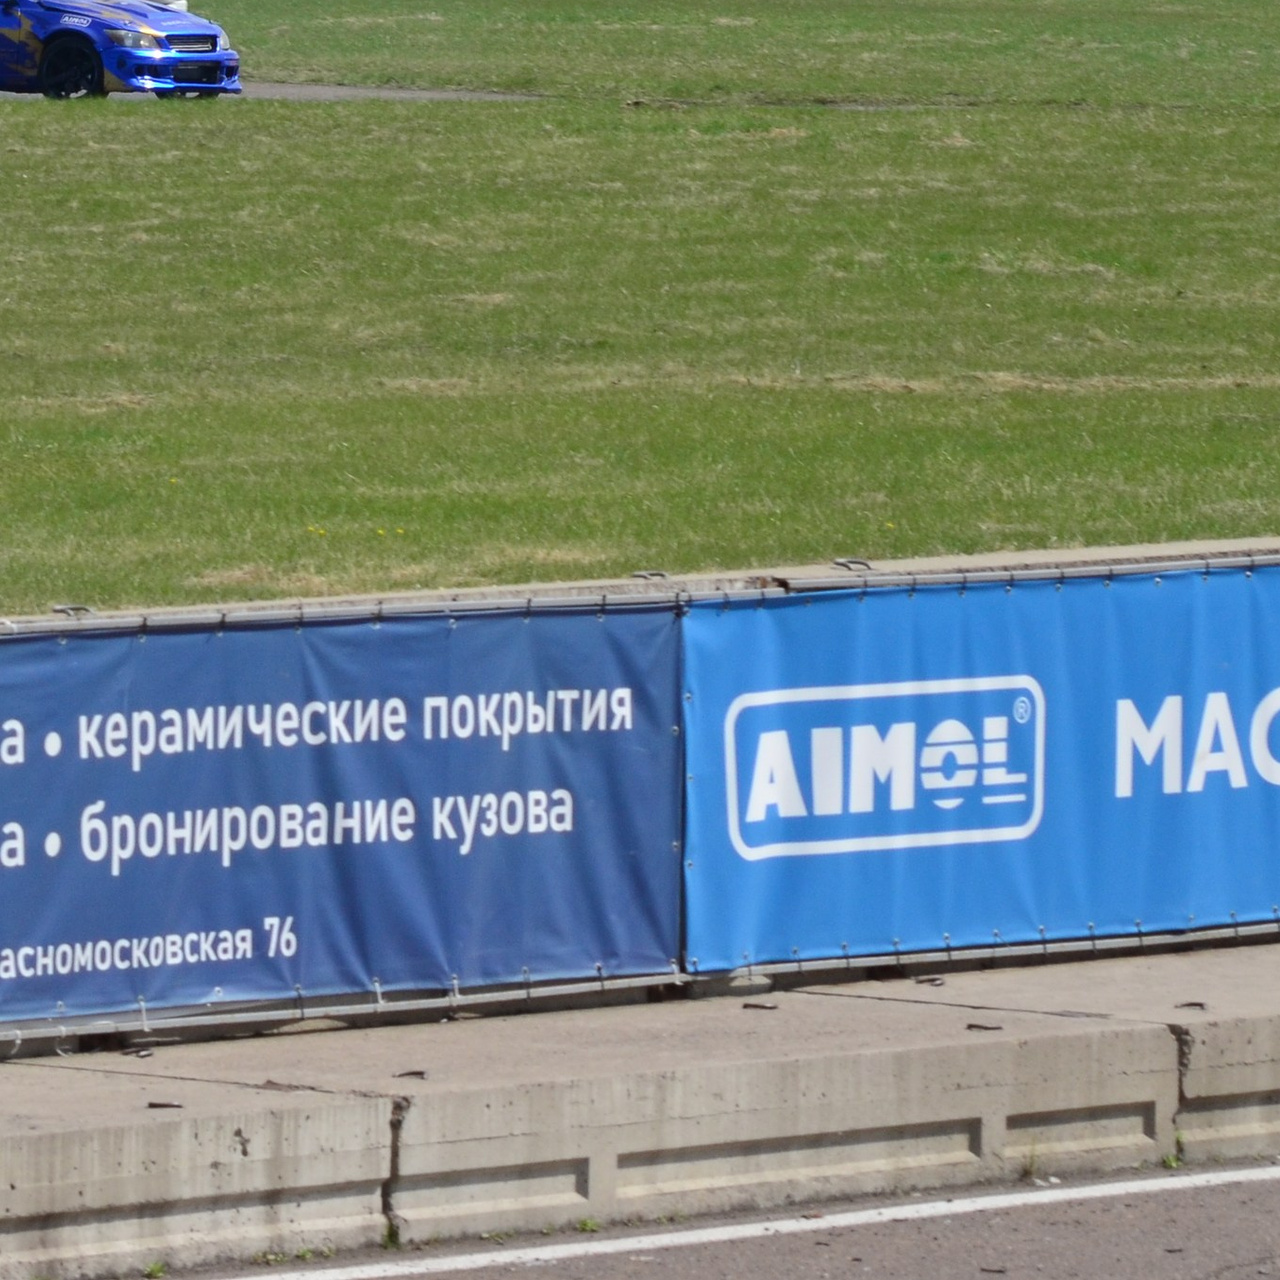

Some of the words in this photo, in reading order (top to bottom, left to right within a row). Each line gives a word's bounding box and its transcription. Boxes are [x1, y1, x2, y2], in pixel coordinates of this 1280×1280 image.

[78, 696, 407, 772] керамические
[423, 687, 633, 752] покрытия
[80, 797, 416, 877] бронирование
[432, 788, 574, 855] кузова
[263, 916, 297, 958] 76
